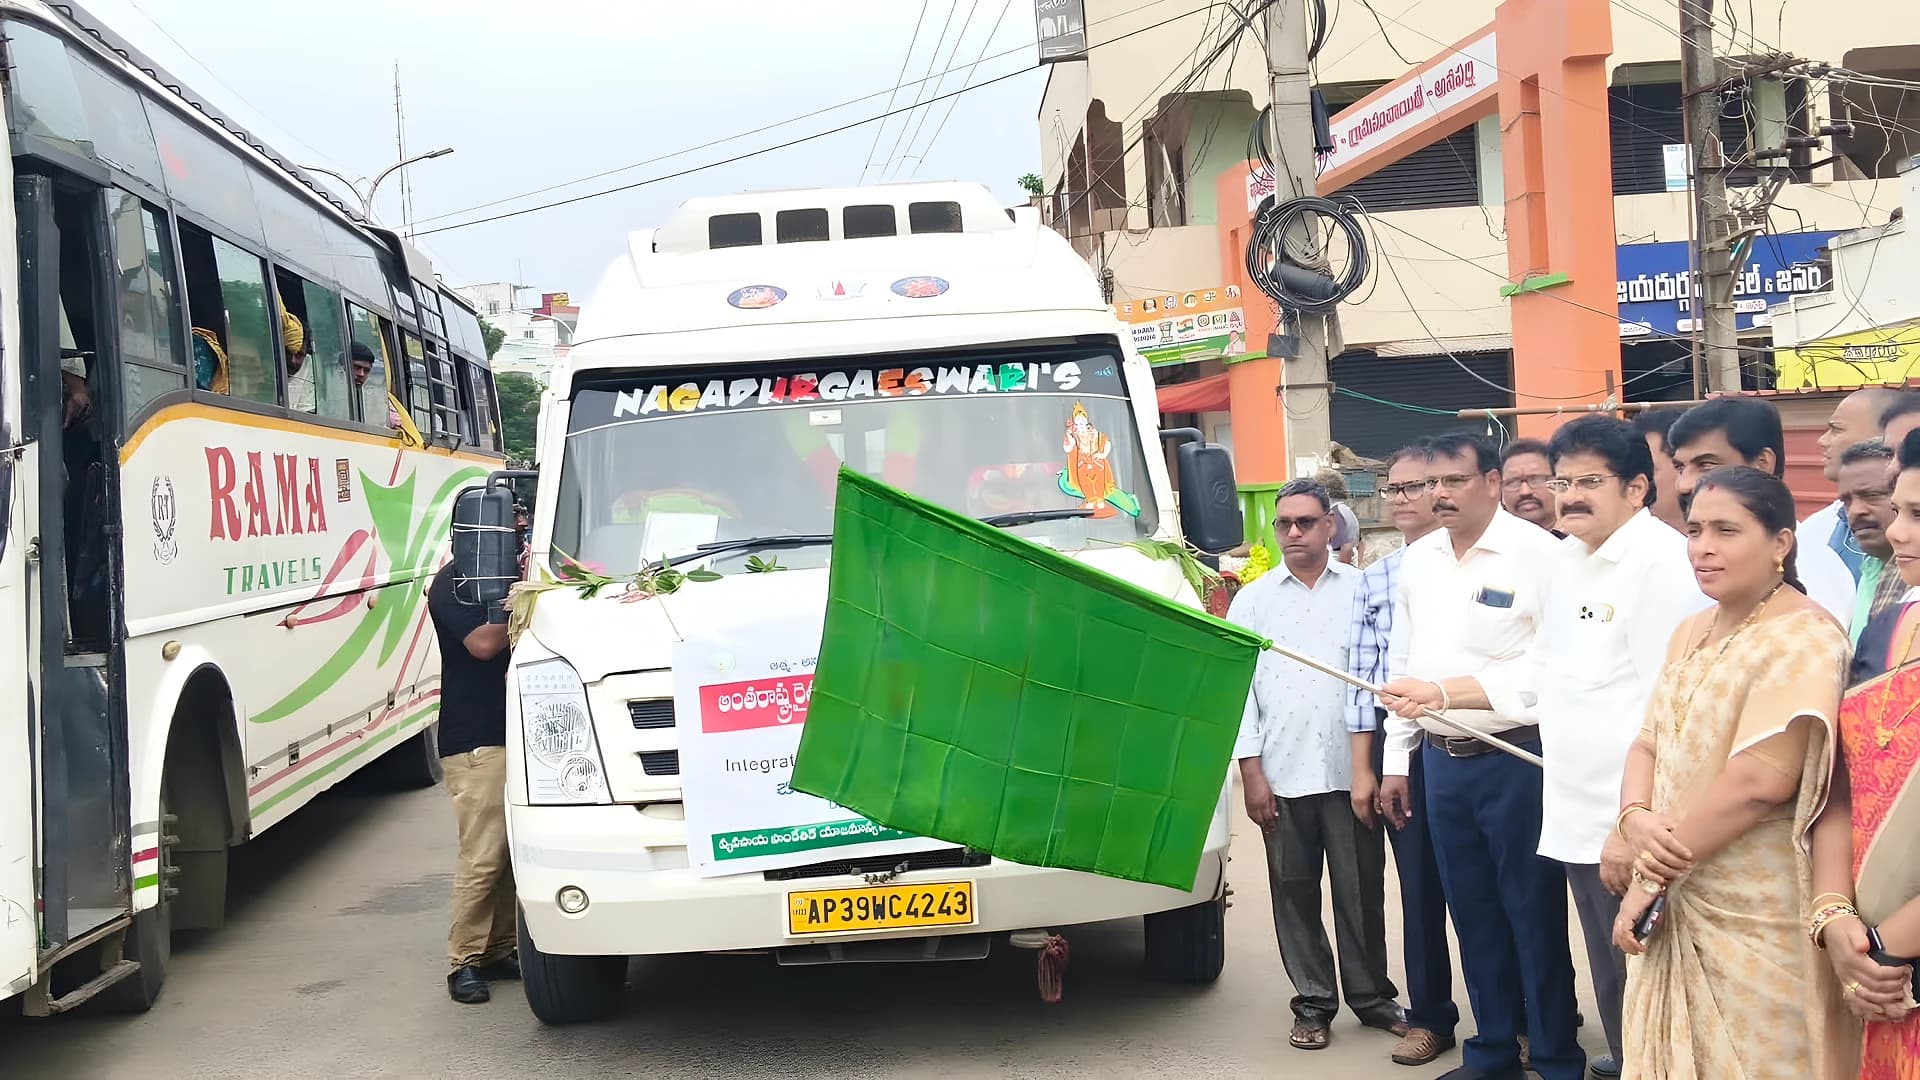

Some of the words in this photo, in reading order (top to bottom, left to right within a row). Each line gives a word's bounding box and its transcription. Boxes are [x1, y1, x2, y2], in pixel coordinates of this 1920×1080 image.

[1776, 265, 1823, 294] జనర
[204, 446, 328, 542] RAMA
[223, 556, 322, 595] TRAVELS
[725, 754, 797, 774] Integrat
[807, 890, 969, 925] AP39WC4243
